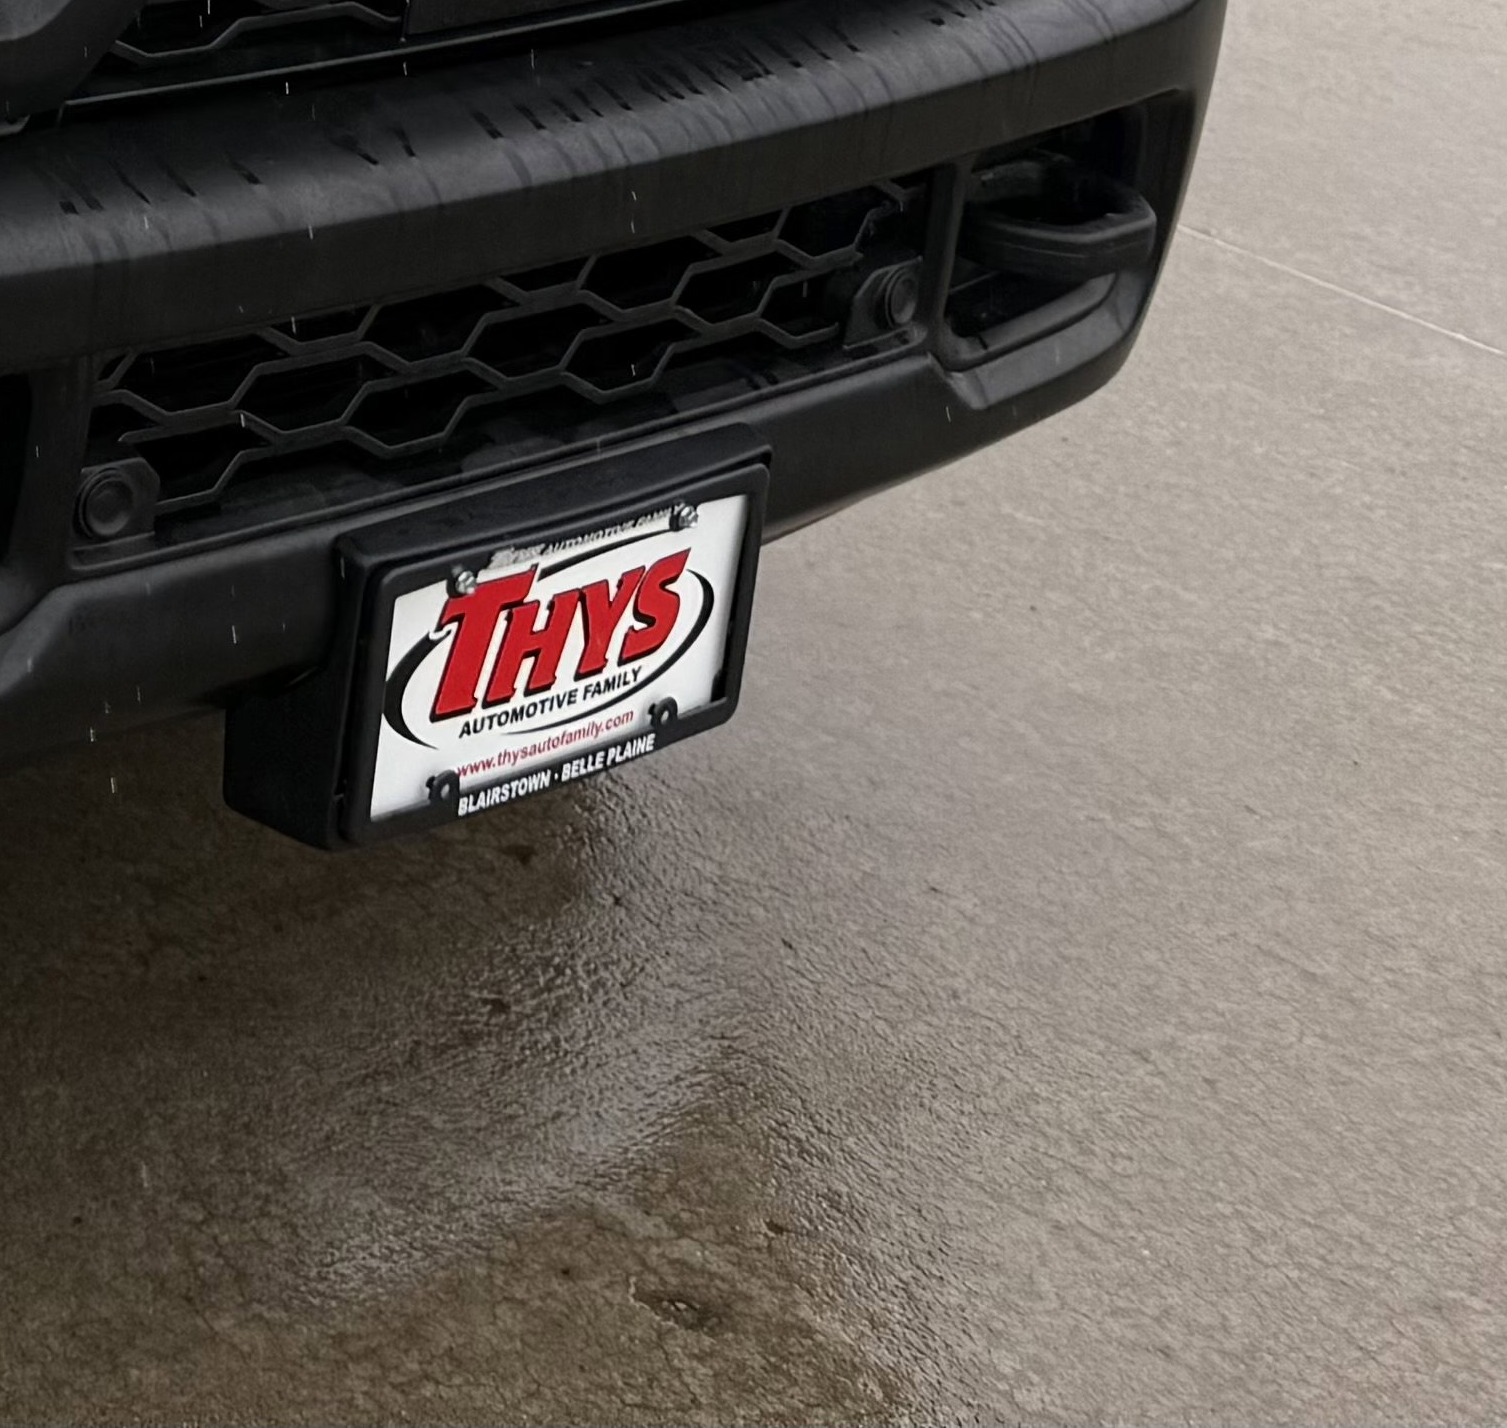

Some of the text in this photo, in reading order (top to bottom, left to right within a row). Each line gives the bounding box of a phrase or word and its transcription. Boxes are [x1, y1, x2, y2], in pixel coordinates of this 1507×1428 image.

[429, 547, 692, 723] THYS
[458, 665, 642, 739] AUTOMOTIVE FAMILY
[456, 710, 634, 777] www.thysautofamily.com
[457, 733, 656, 817] BLAIRSTOWN BELLE PLAINE
